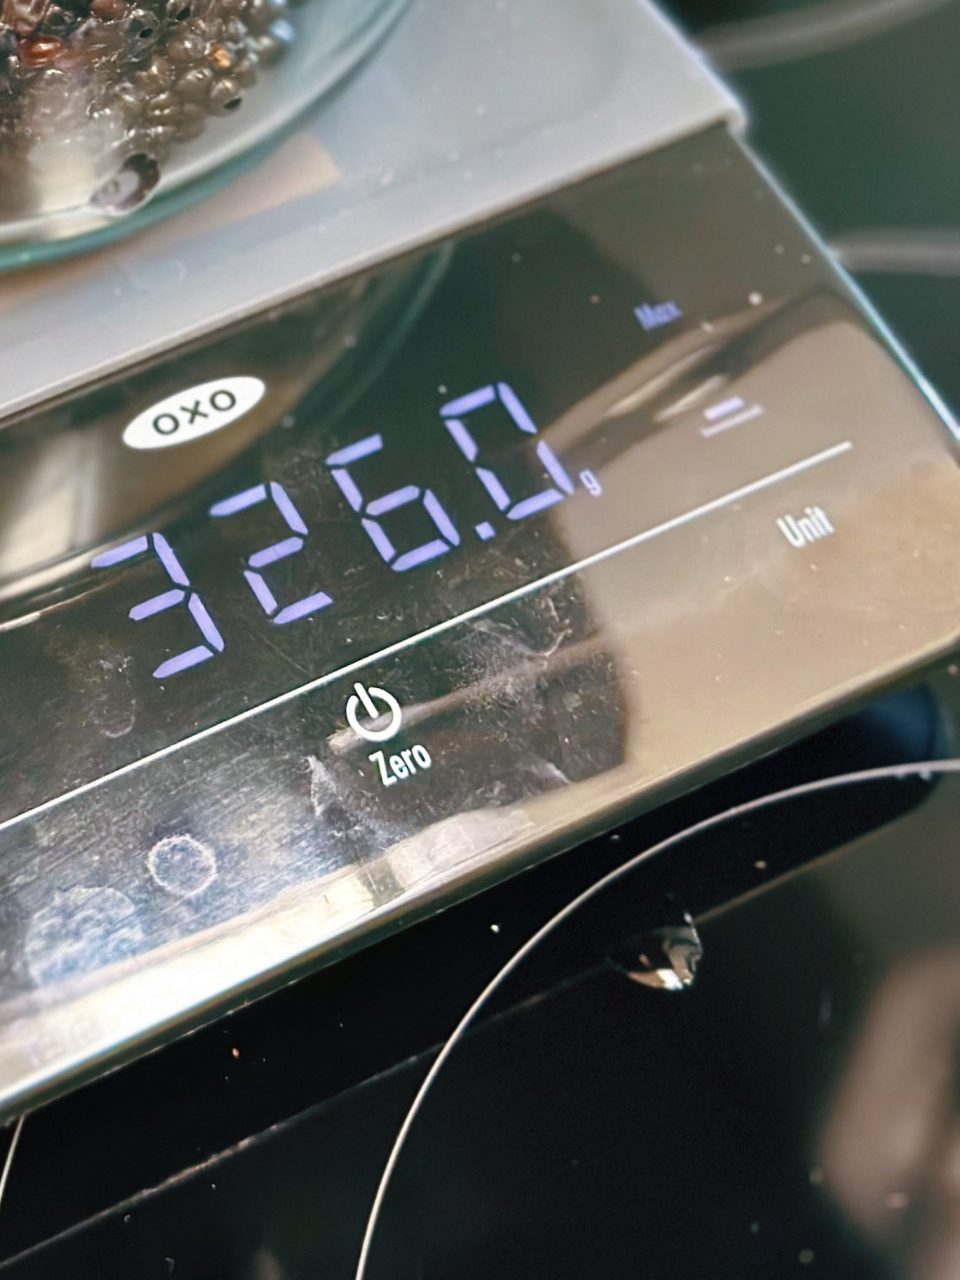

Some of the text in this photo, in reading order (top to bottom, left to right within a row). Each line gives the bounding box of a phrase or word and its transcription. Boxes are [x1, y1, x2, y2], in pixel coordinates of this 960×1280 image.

[634, 302, 680, 330] Max
[91, 381, 574, 679] 326.0
[777, 505, 834, 548] Unit
[369, 744, 432, 787] Zero
